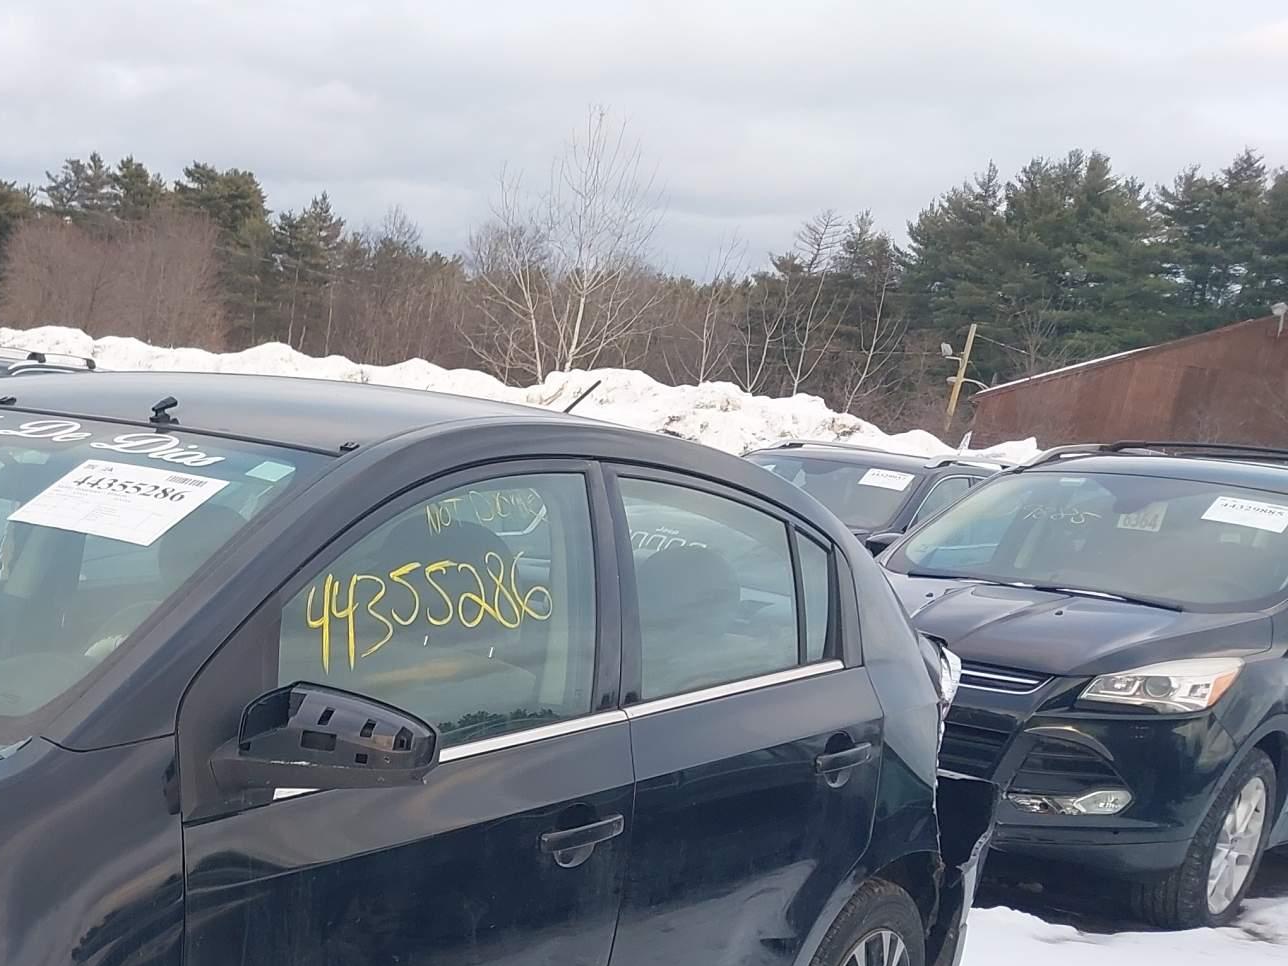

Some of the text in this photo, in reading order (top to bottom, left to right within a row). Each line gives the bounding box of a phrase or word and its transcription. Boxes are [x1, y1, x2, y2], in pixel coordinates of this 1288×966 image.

[89, 432, 226, 468] Dios
[72, 473, 187, 503] 44355286
[306, 551, 553, 676] 44355286
